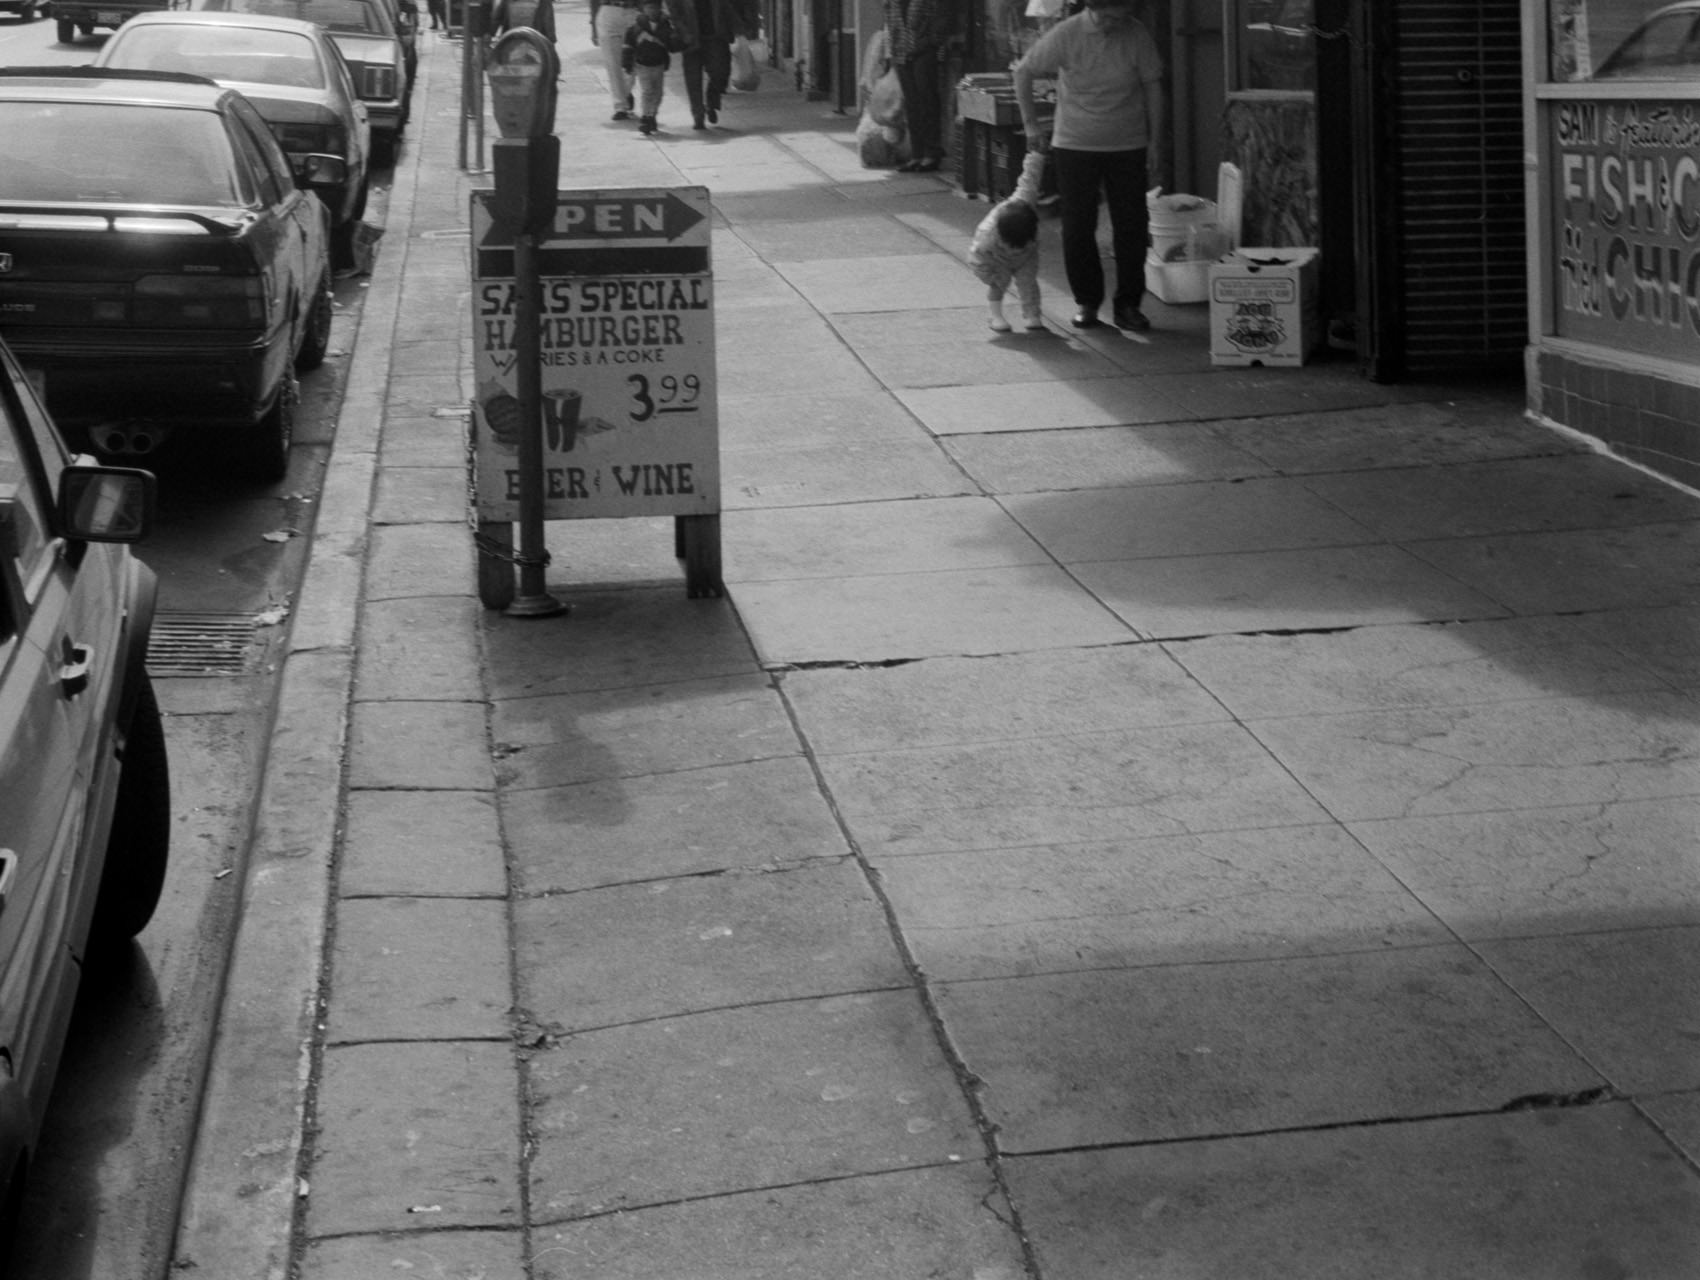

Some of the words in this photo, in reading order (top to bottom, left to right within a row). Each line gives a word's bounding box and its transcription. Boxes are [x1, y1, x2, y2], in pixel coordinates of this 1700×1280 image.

[553, 202, 665, 233] PEN
[580, 278, 709, 312] SPECIAL
[484, 314, 684, 351] HMBURGER
[540, 350, 577, 367] RIES
[613, 347, 665, 364] COKE
[504, 467, 589, 502] BER
[612, 462, 695, 497] WINE
